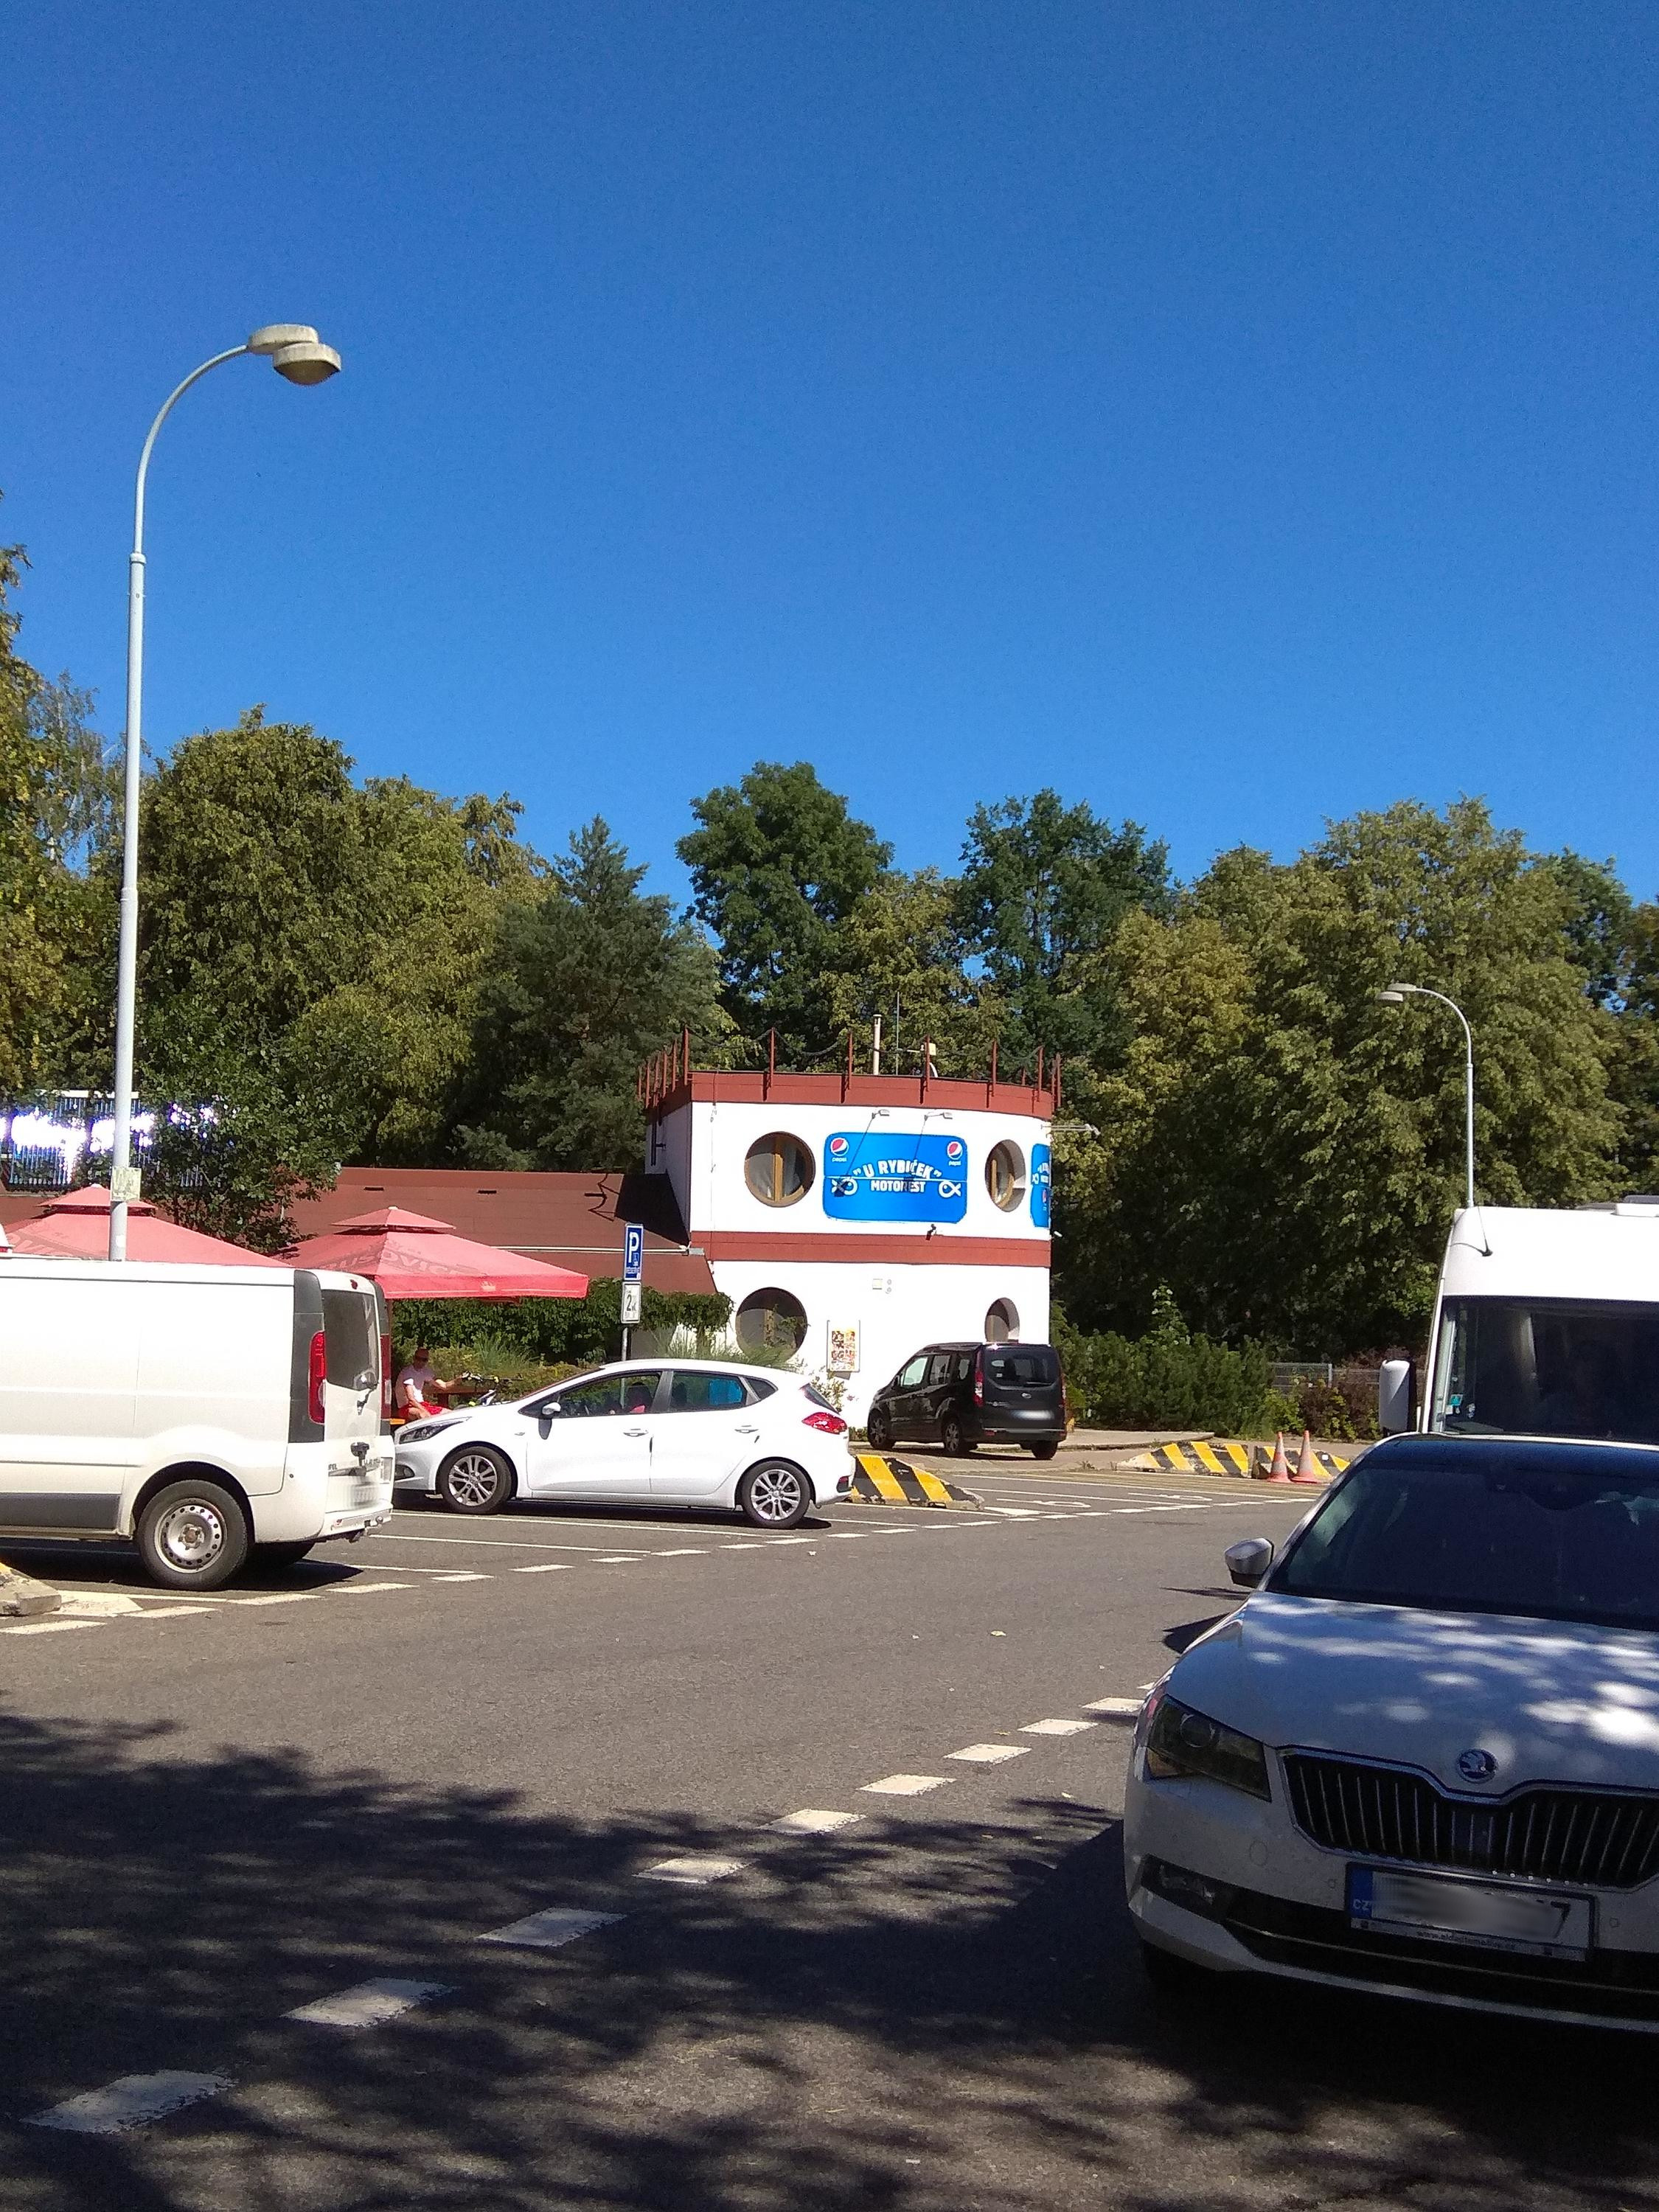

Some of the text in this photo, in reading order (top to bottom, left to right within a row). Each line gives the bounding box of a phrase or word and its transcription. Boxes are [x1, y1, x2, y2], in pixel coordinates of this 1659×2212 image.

[871, 1180, 926, 1192] MOTOREST
[628, 1232, 639, 1263] P
[1352, 1899, 1369, 1910] CZ
